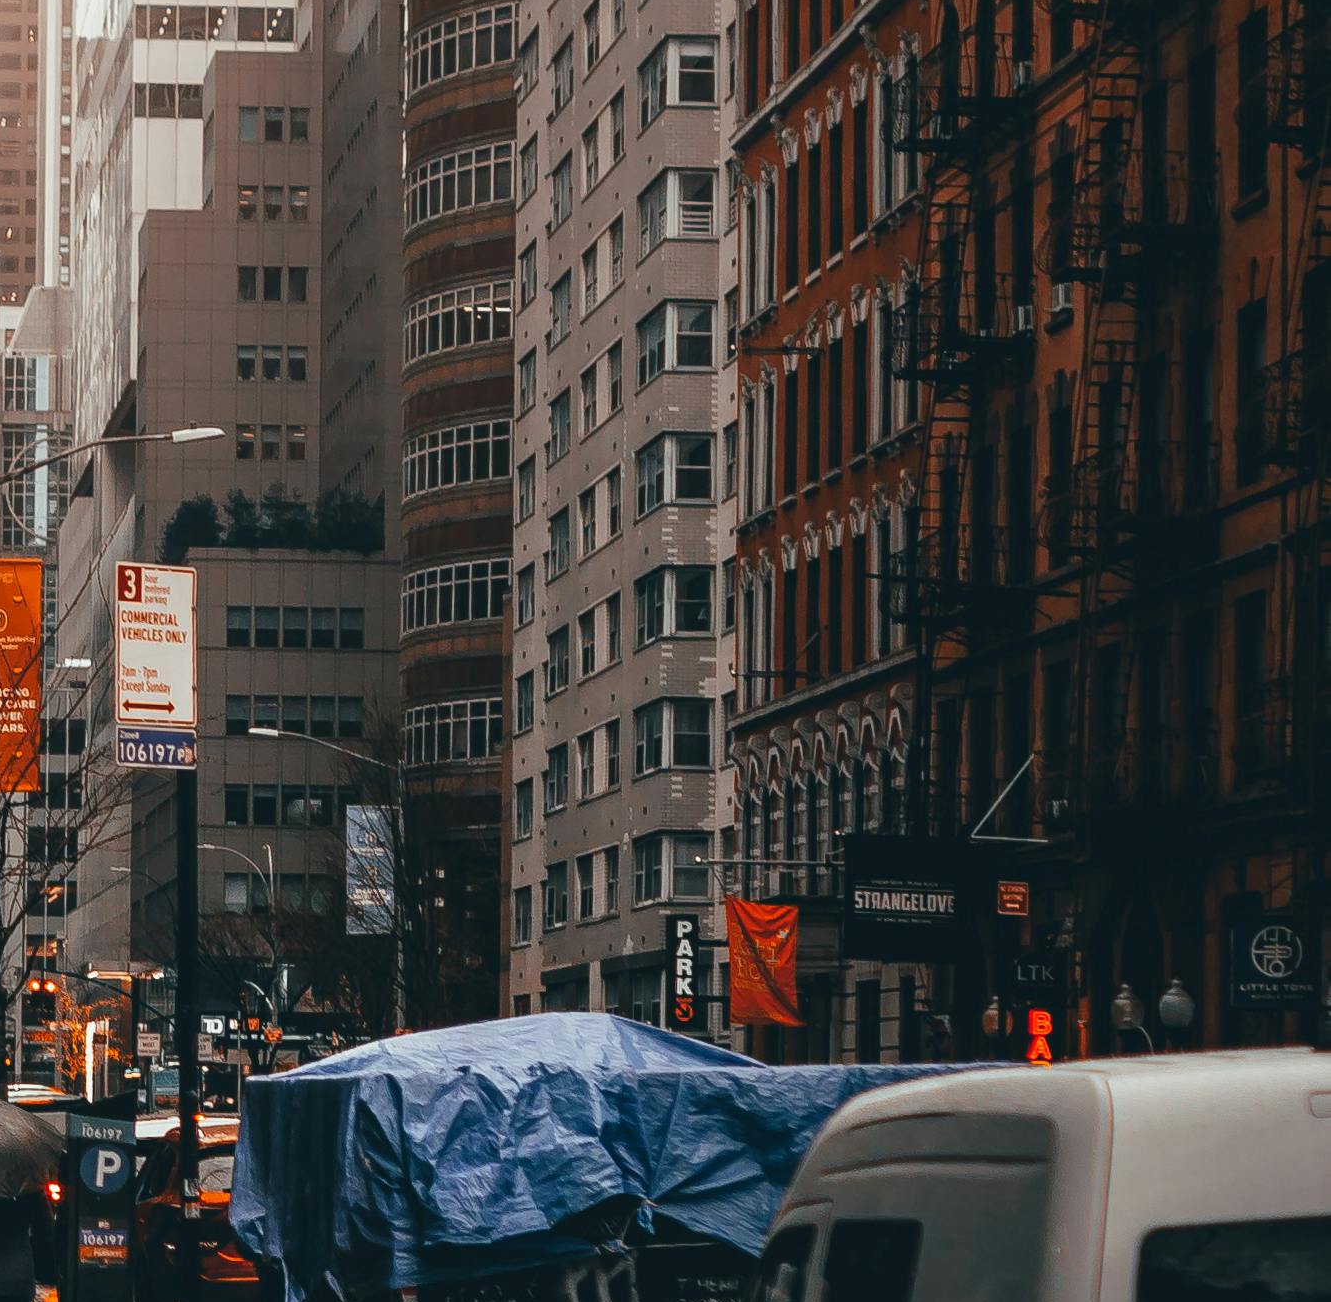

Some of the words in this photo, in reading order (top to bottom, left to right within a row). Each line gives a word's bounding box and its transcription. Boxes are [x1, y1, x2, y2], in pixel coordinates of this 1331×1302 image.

[123, 568, 137, 599] 3
[121, 609, 179, 627] COMMERCIAL
[121, 627, 163, 642] VEHICLES
[166, 630, 187, 644] ONLY
[122, 665, 137, 677] 7am
[142, 666, 157, 678] 7pm
[121, 679, 145, 693] Except
[146, 682, 171, 696] Sunday
[5, 700, 37, 710] CARE
[120, 742, 176, 764] 106197
[854, 890, 955, 913] STRANGELOVE
[676, 920, 694, 996] PARK
[1017, 964, 1054, 981] LTK
[203, 1018, 224, 1034] TD
[1027, 1009, 1054, 1068] BA
[82, 1123, 123, 1140] 106197
[95, 1149, 122, 1188] P
[83, 1234, 125, 1246] 106197
